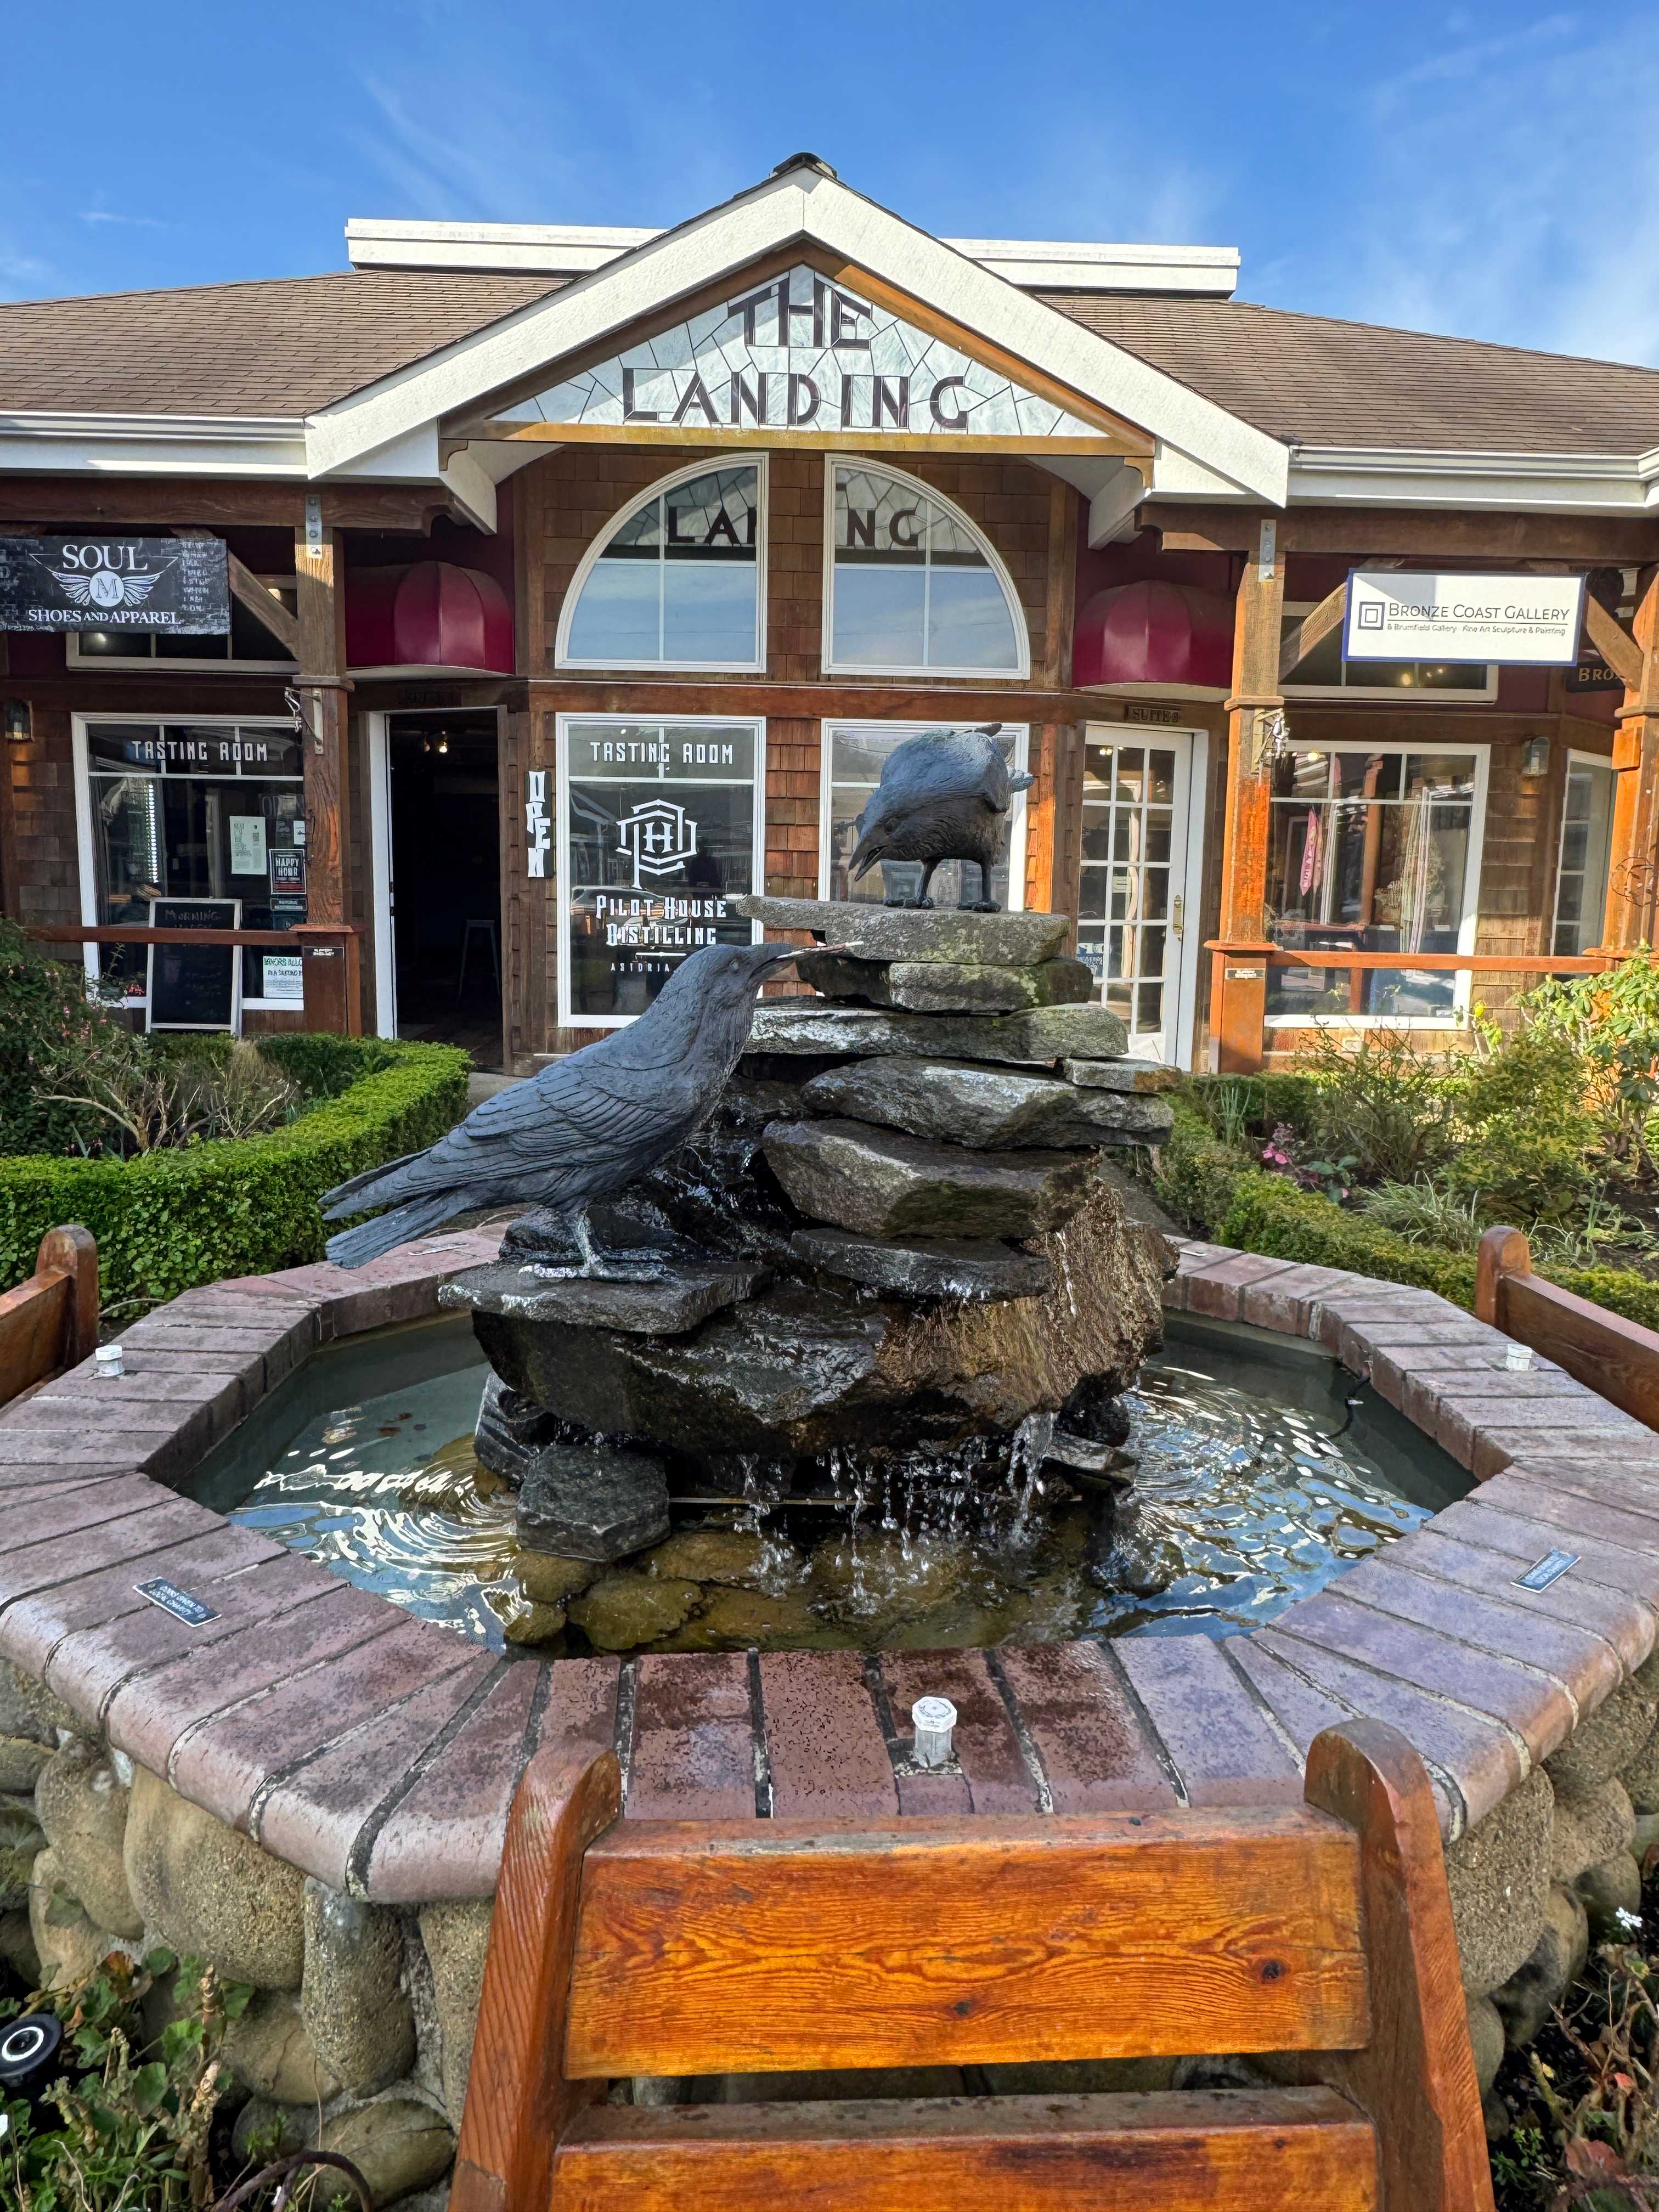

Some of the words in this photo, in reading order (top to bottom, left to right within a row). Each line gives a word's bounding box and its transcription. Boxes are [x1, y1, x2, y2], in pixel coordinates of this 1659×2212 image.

[728, 277, 872, 349] THE
[622, 368, 969, 429] LANDING
[62, 544, 148, 571] SOUL
[29, 610, 81, 623] SHOES
[83, 612, 109, 622] AND
[109, 611, 182, 624] APPAREL
[1389, 603, 1449, 618] BRONZE
[1453, 604, 1500, 619] COAST
[1505, 605, 1570, 620] GALLERY
[1432, 624, 1457, 633] Gallery
[1579, 667, 1618, 682] BRO
[132, 741, 207, 760] TASTING
[219, 742, 267, 761] ROOM
[590, 742, 670, 763] TASTING
[682, 743, 733, 764] ROOM
[526, 771, 551, 878] OPEN
[275, 857, 299, 867] HAPPY
[278, 867, 298, 877] HOUR
[596, 895, 654, 919] PILOT
[664, 897, 726, 919] HOUSE
[606, 923, 716, 946] DISTILLING
[611, 962, 670, 972] ASTORIA
